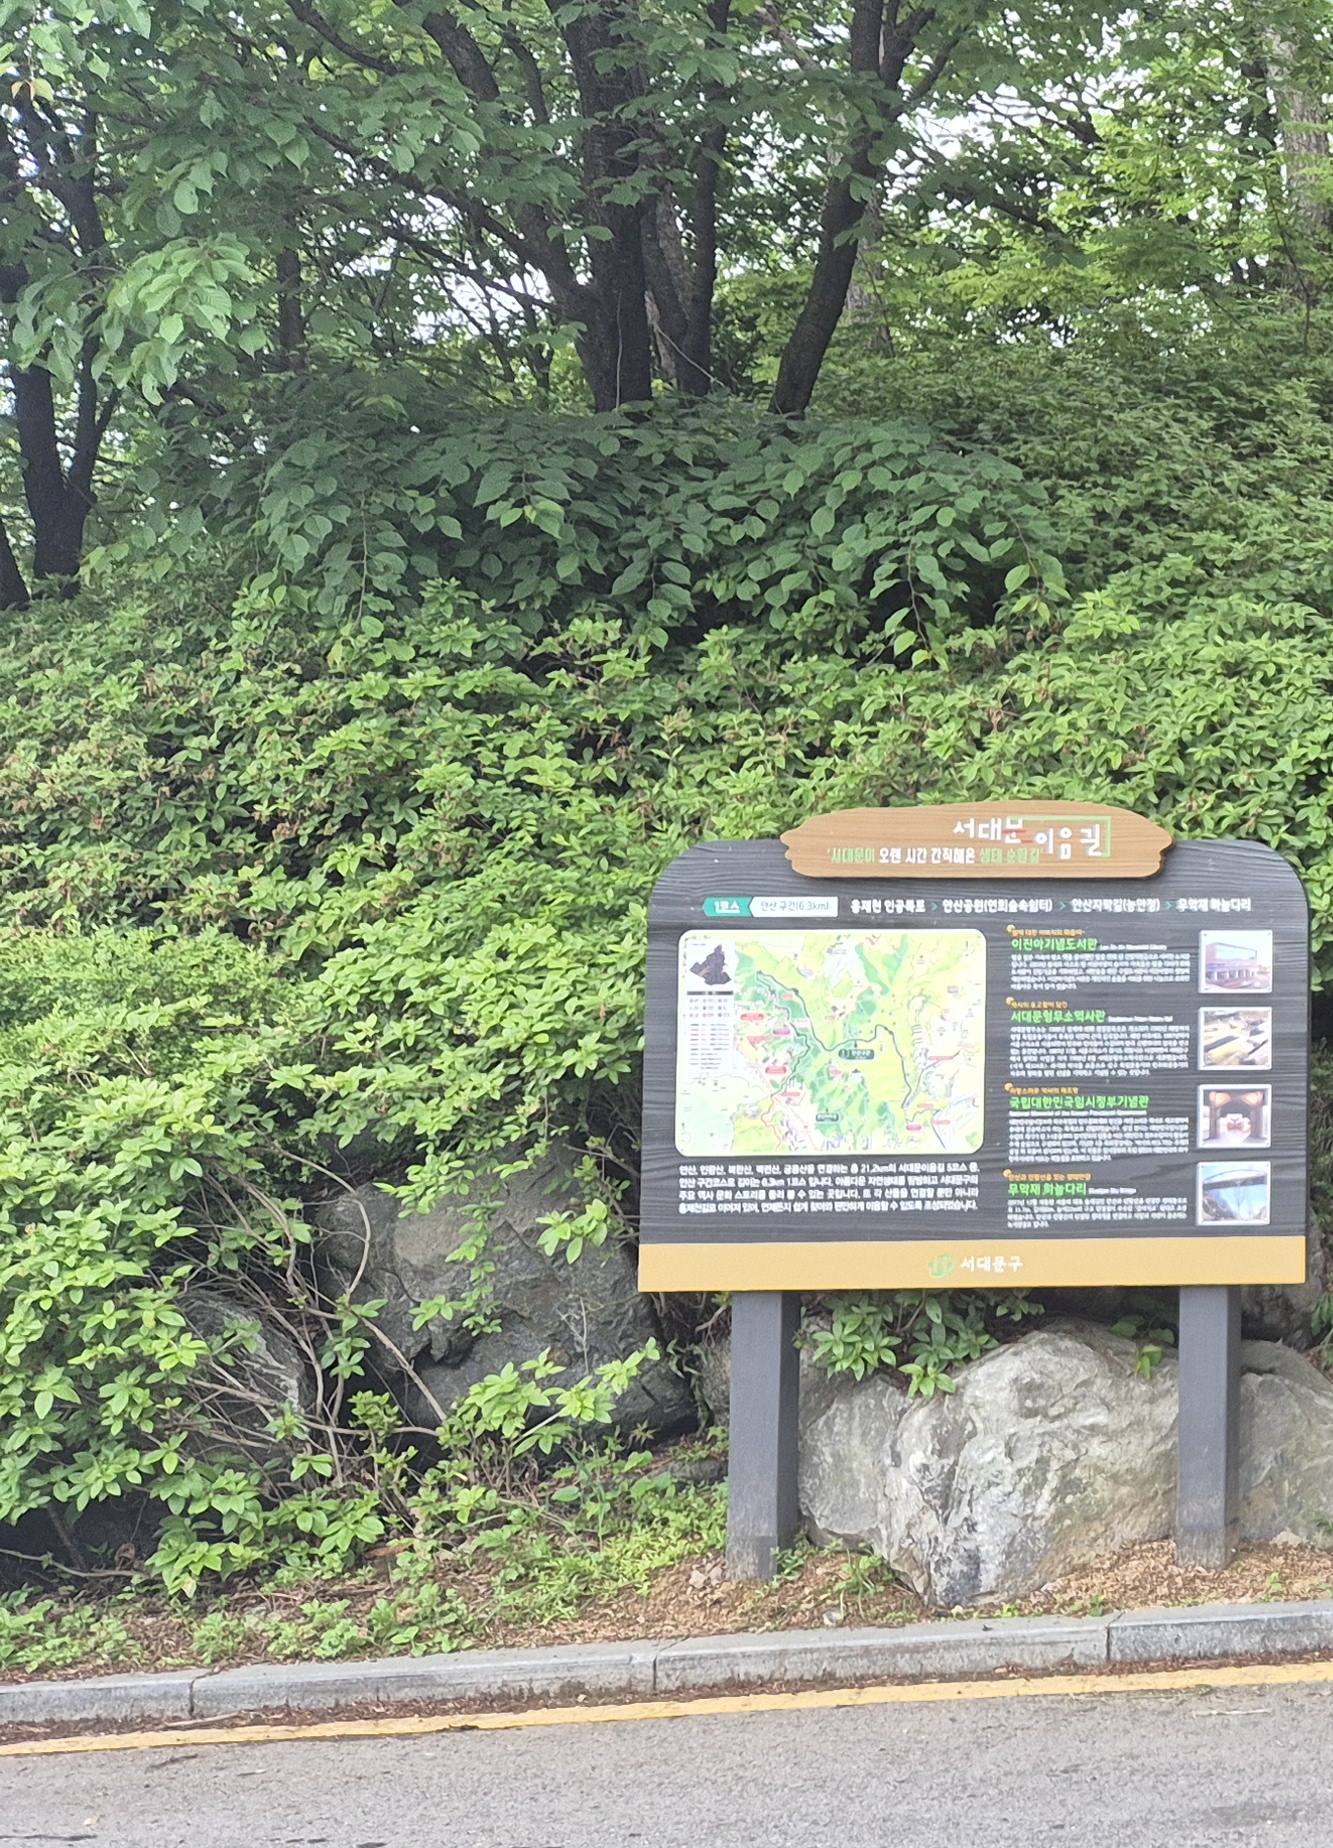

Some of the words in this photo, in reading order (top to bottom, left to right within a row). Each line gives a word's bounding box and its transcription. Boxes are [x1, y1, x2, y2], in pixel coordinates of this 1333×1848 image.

[953, 817, 1025, 844] 서대문
[879, 848, 902, 864] 오랜
[905, 848, 927, 864] 시간
[931, 848, 976, 864] 간직해온
[761, 900, 778, 912] 안산
[851, 899, 881, 914] 홍제천
[884, 899, 926, 914] 인공폭포
[1011, 938, 1098, 951] 이진아기념도서관
[1010, 1010, 1106, 1023] 서대문형무소역사관
[1009, 1095, 1149, 1109] 국립대한민국임시정부기념관
[1008, 1183, 1040, 1196] 무악재
[1044, 1183, 1087, 1196] 하늘다리
[960, 1255, 1023, 1273] 서대문구
